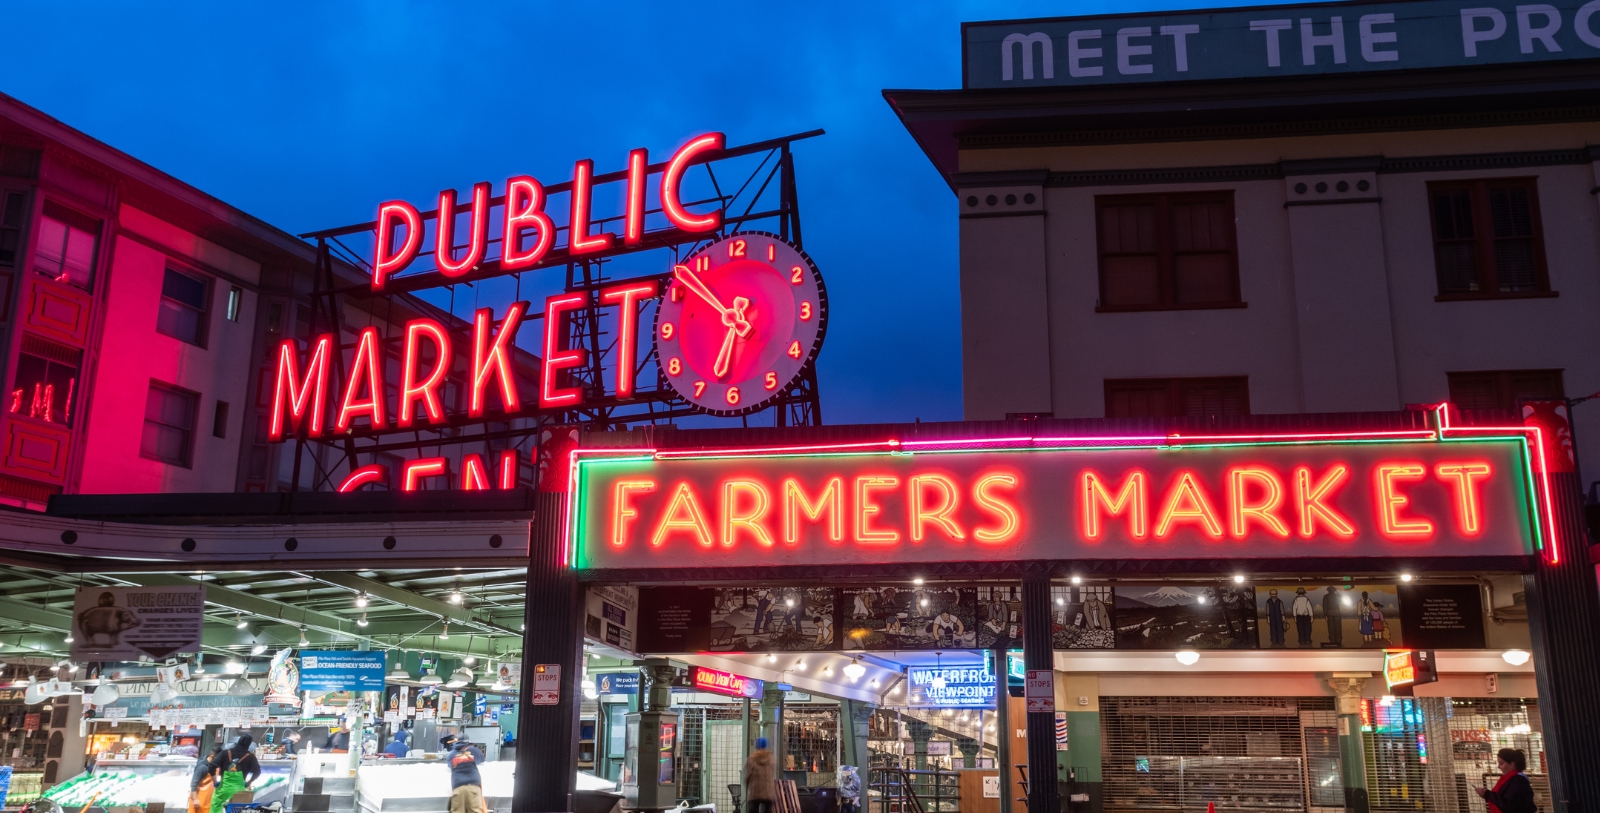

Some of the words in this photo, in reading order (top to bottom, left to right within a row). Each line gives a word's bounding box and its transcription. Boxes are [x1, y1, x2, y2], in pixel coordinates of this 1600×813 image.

[1001, 24, 1199, 81] MEET
[1249, 13, 1400, 68] THE
[371, 132, 726, 291] PUBLIC
[728, 239, 746, 257] 12
[768, 243, 775, 262] 1
[696, 256, 709, 272] 11
[791, 266, 803, 284] 2
[799, 302, 812, 320] 3
[661, 323, 674, 340] 9
[787, 341, 801, 359] 4
[268, 279, 659, 442] MARKET
[668, 358, 682, 375] 8
[764, 372, 777, 389] 5
[694, 381, 706, 398] 7
[726, 386, 739, 405] 6
[613, 475, 1017, 545] FARMERS
[1083, 465, 1489, 537] MARKET
[127, 593, 156, 607] YOUR
[157, 593, 202, 607] CHANGE
[537, 674, 558, 682] STOPS
[913, 669, 996, 685] WATERFRO
[1029, 680, 1051, 688] STOPS
[925, 685, 996, 698] VIEWPOINT
